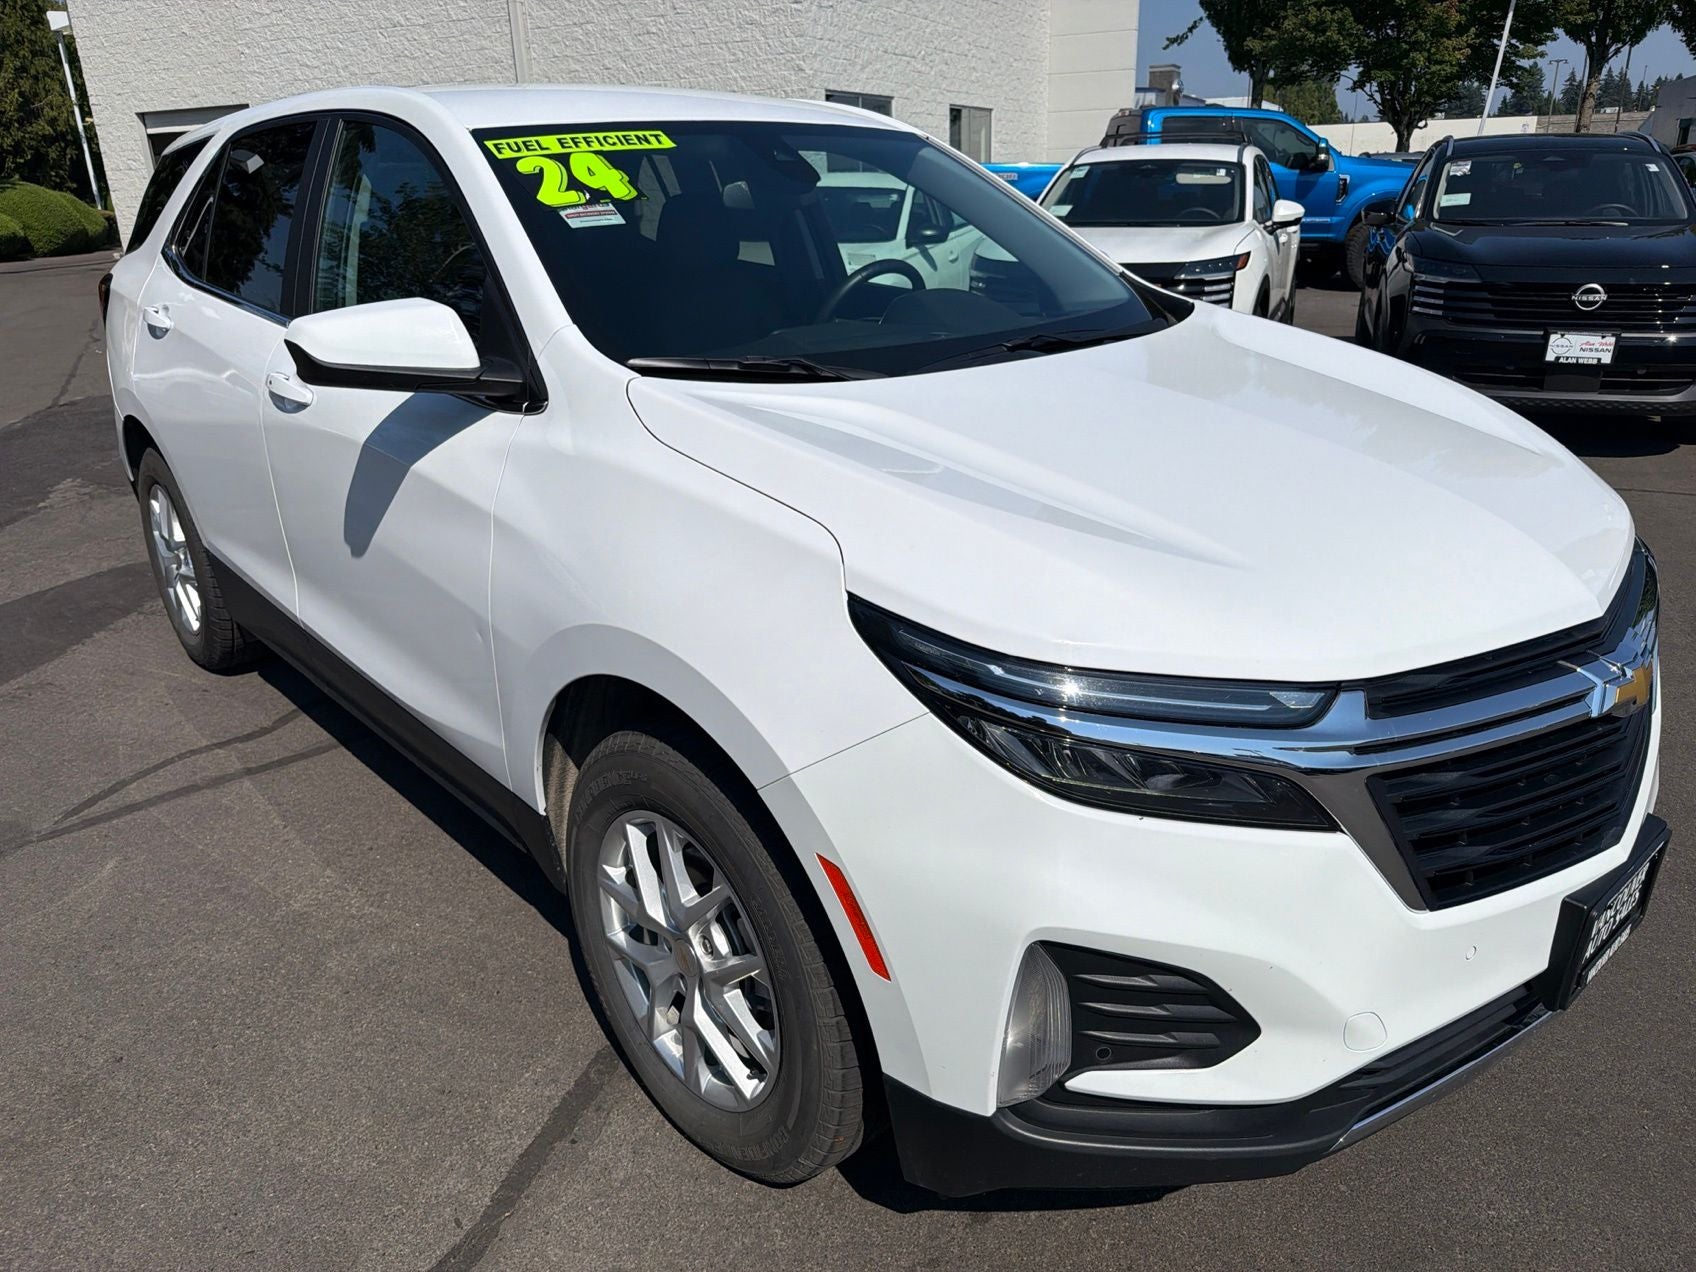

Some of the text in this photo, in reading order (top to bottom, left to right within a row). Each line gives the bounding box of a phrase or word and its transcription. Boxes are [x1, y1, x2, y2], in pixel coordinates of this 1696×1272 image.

[493, 134, 663, 155] FUEL EFFICIENT
[516, 152, 638, 207] 24
[1571, 293, 1608, 301] NISSAN
[1559, 356, 1577, 364] ALAN
[1581, 917, 1614, 965] AUTO
[1612, 884, 1642, 930] SALES
